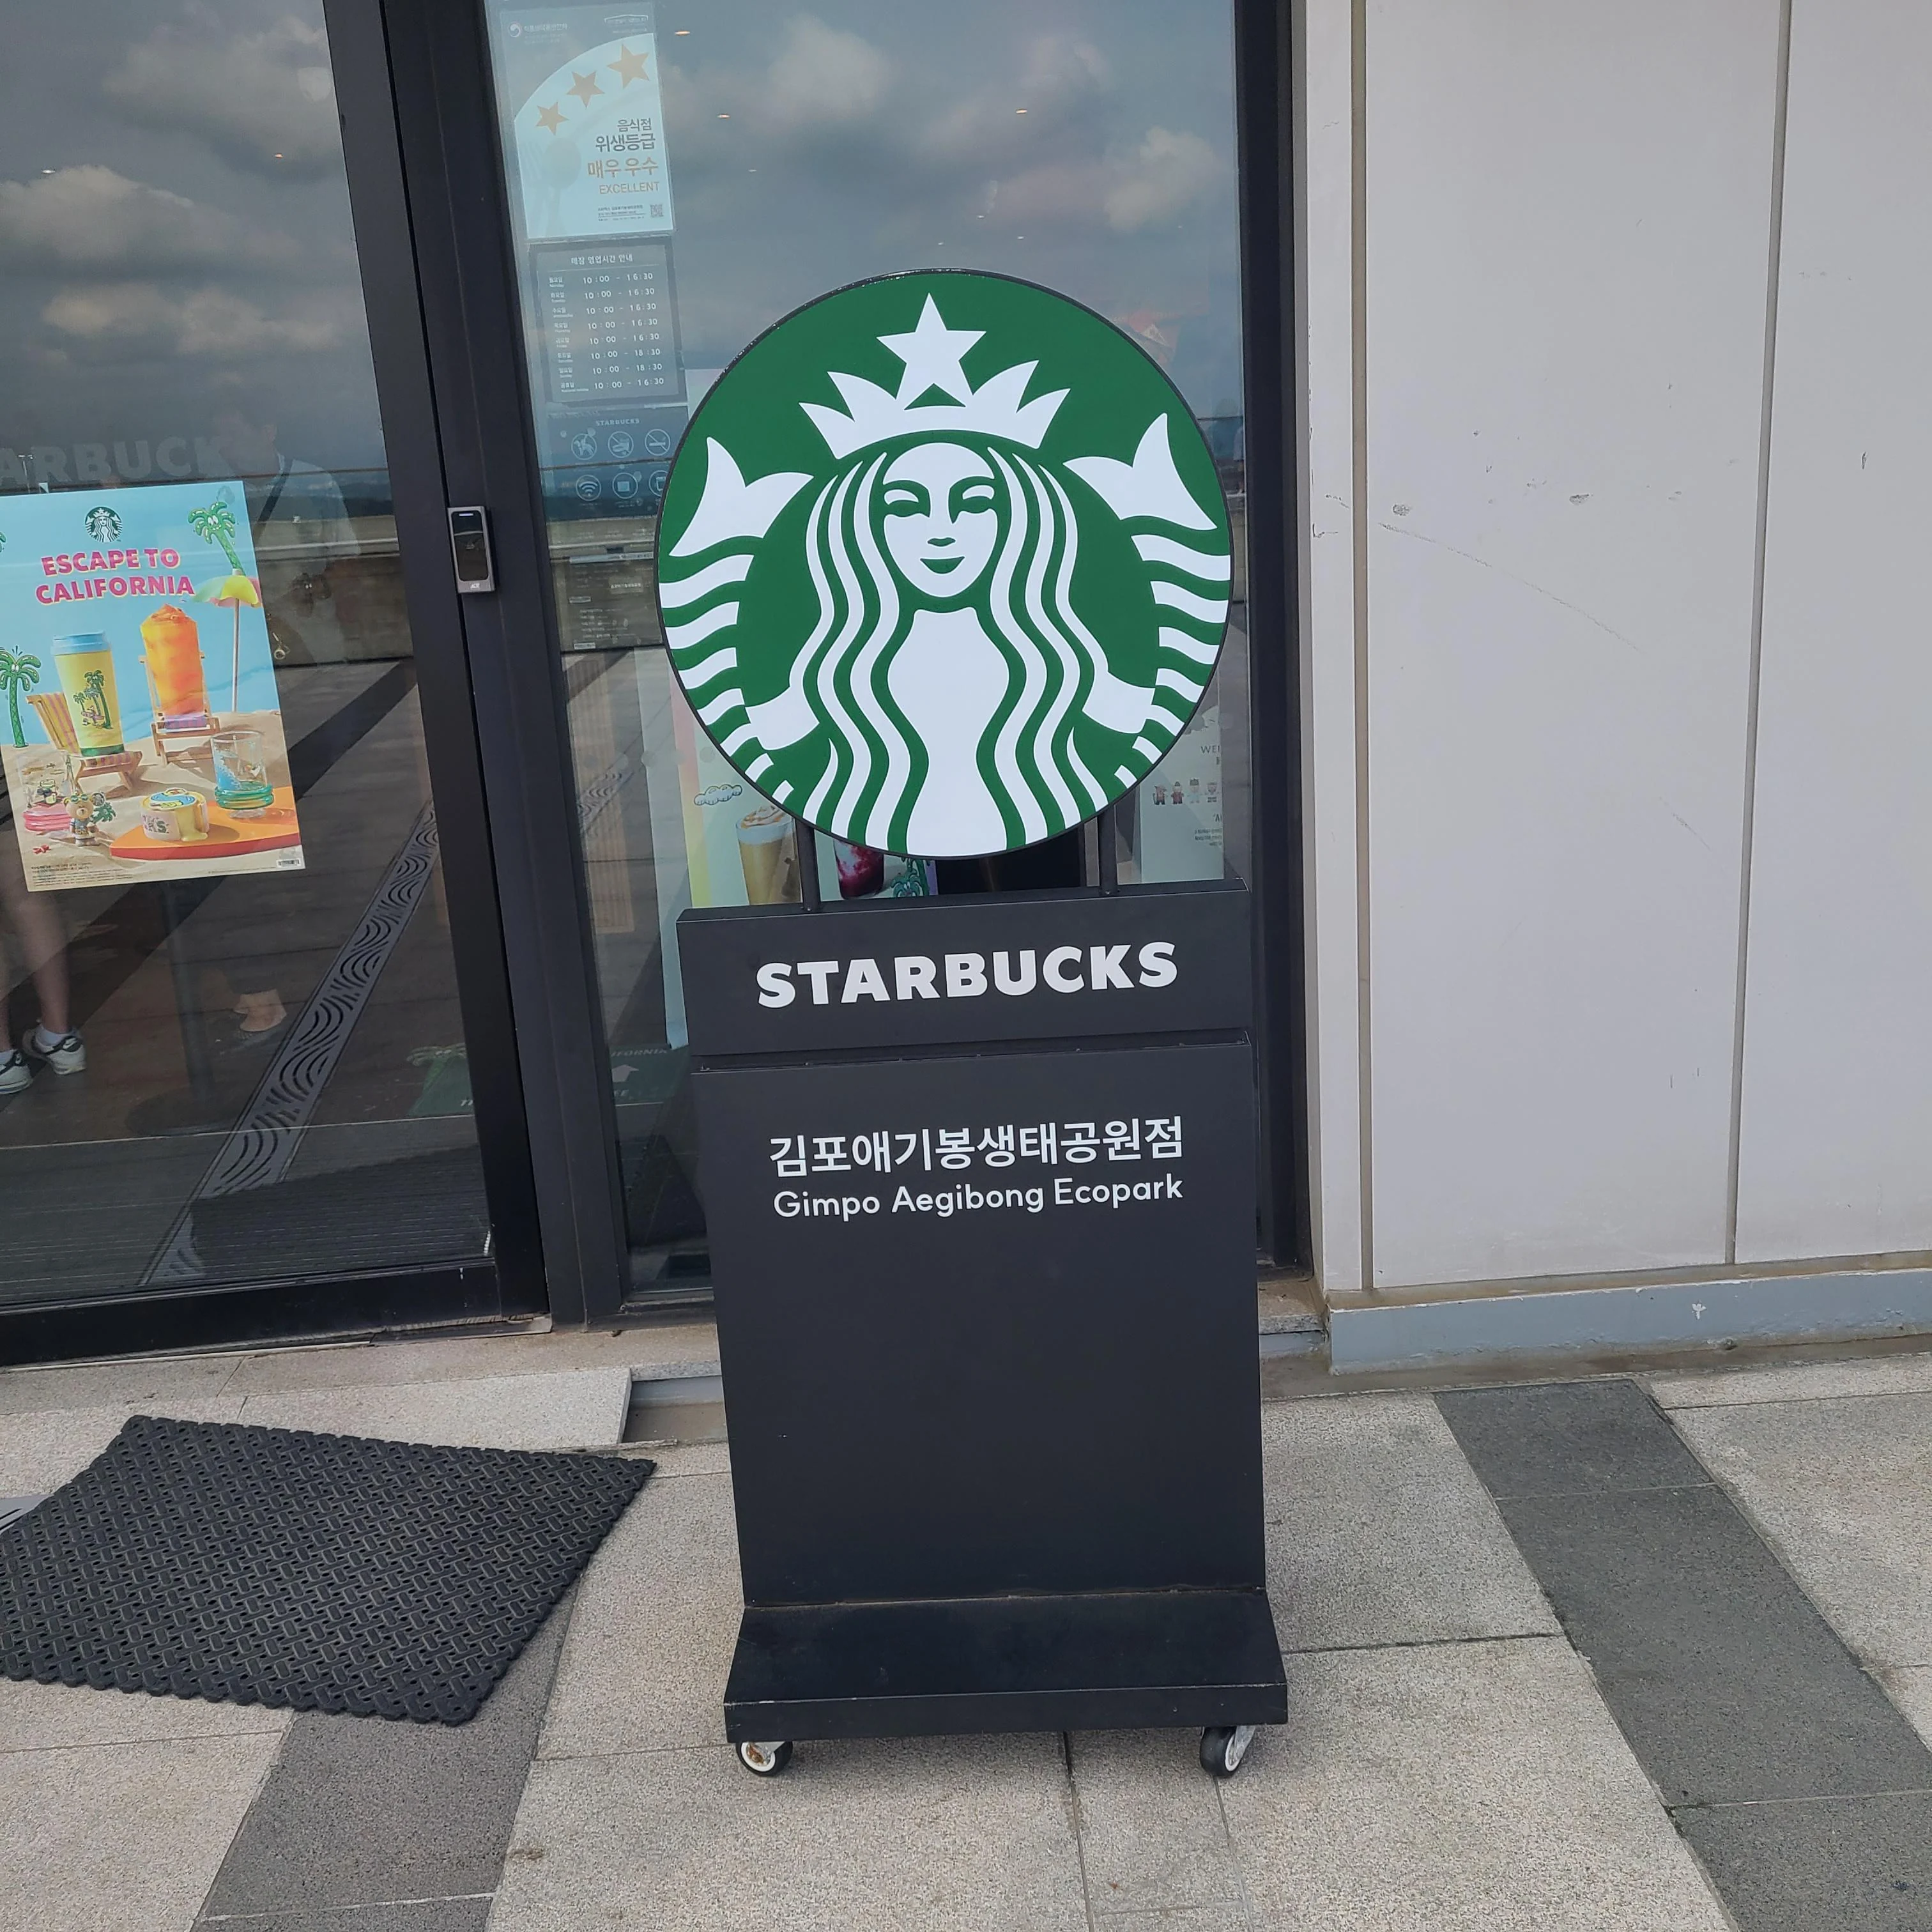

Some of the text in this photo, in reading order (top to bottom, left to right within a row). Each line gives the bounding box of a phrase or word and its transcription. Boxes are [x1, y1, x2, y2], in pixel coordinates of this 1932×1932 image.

[617, 118, 652, 132] 음식점
[595, 132, 656, 153] 위생등급
[587, 157, 659, 179] 매우 우수
[599, 181, 660, 195] EXCELLENT
[41, 548, 181, 577] ESCAPE TO
[35, 575, 195, 604] CALIFORNIA
[756, 942, 1178, 1008] STARBUCKS
[770, 1116, 1183, 1177] 김포애기봉생태공원점
[773, 1173, 1184, 1222] Gimpo Aegibong Ecopark
